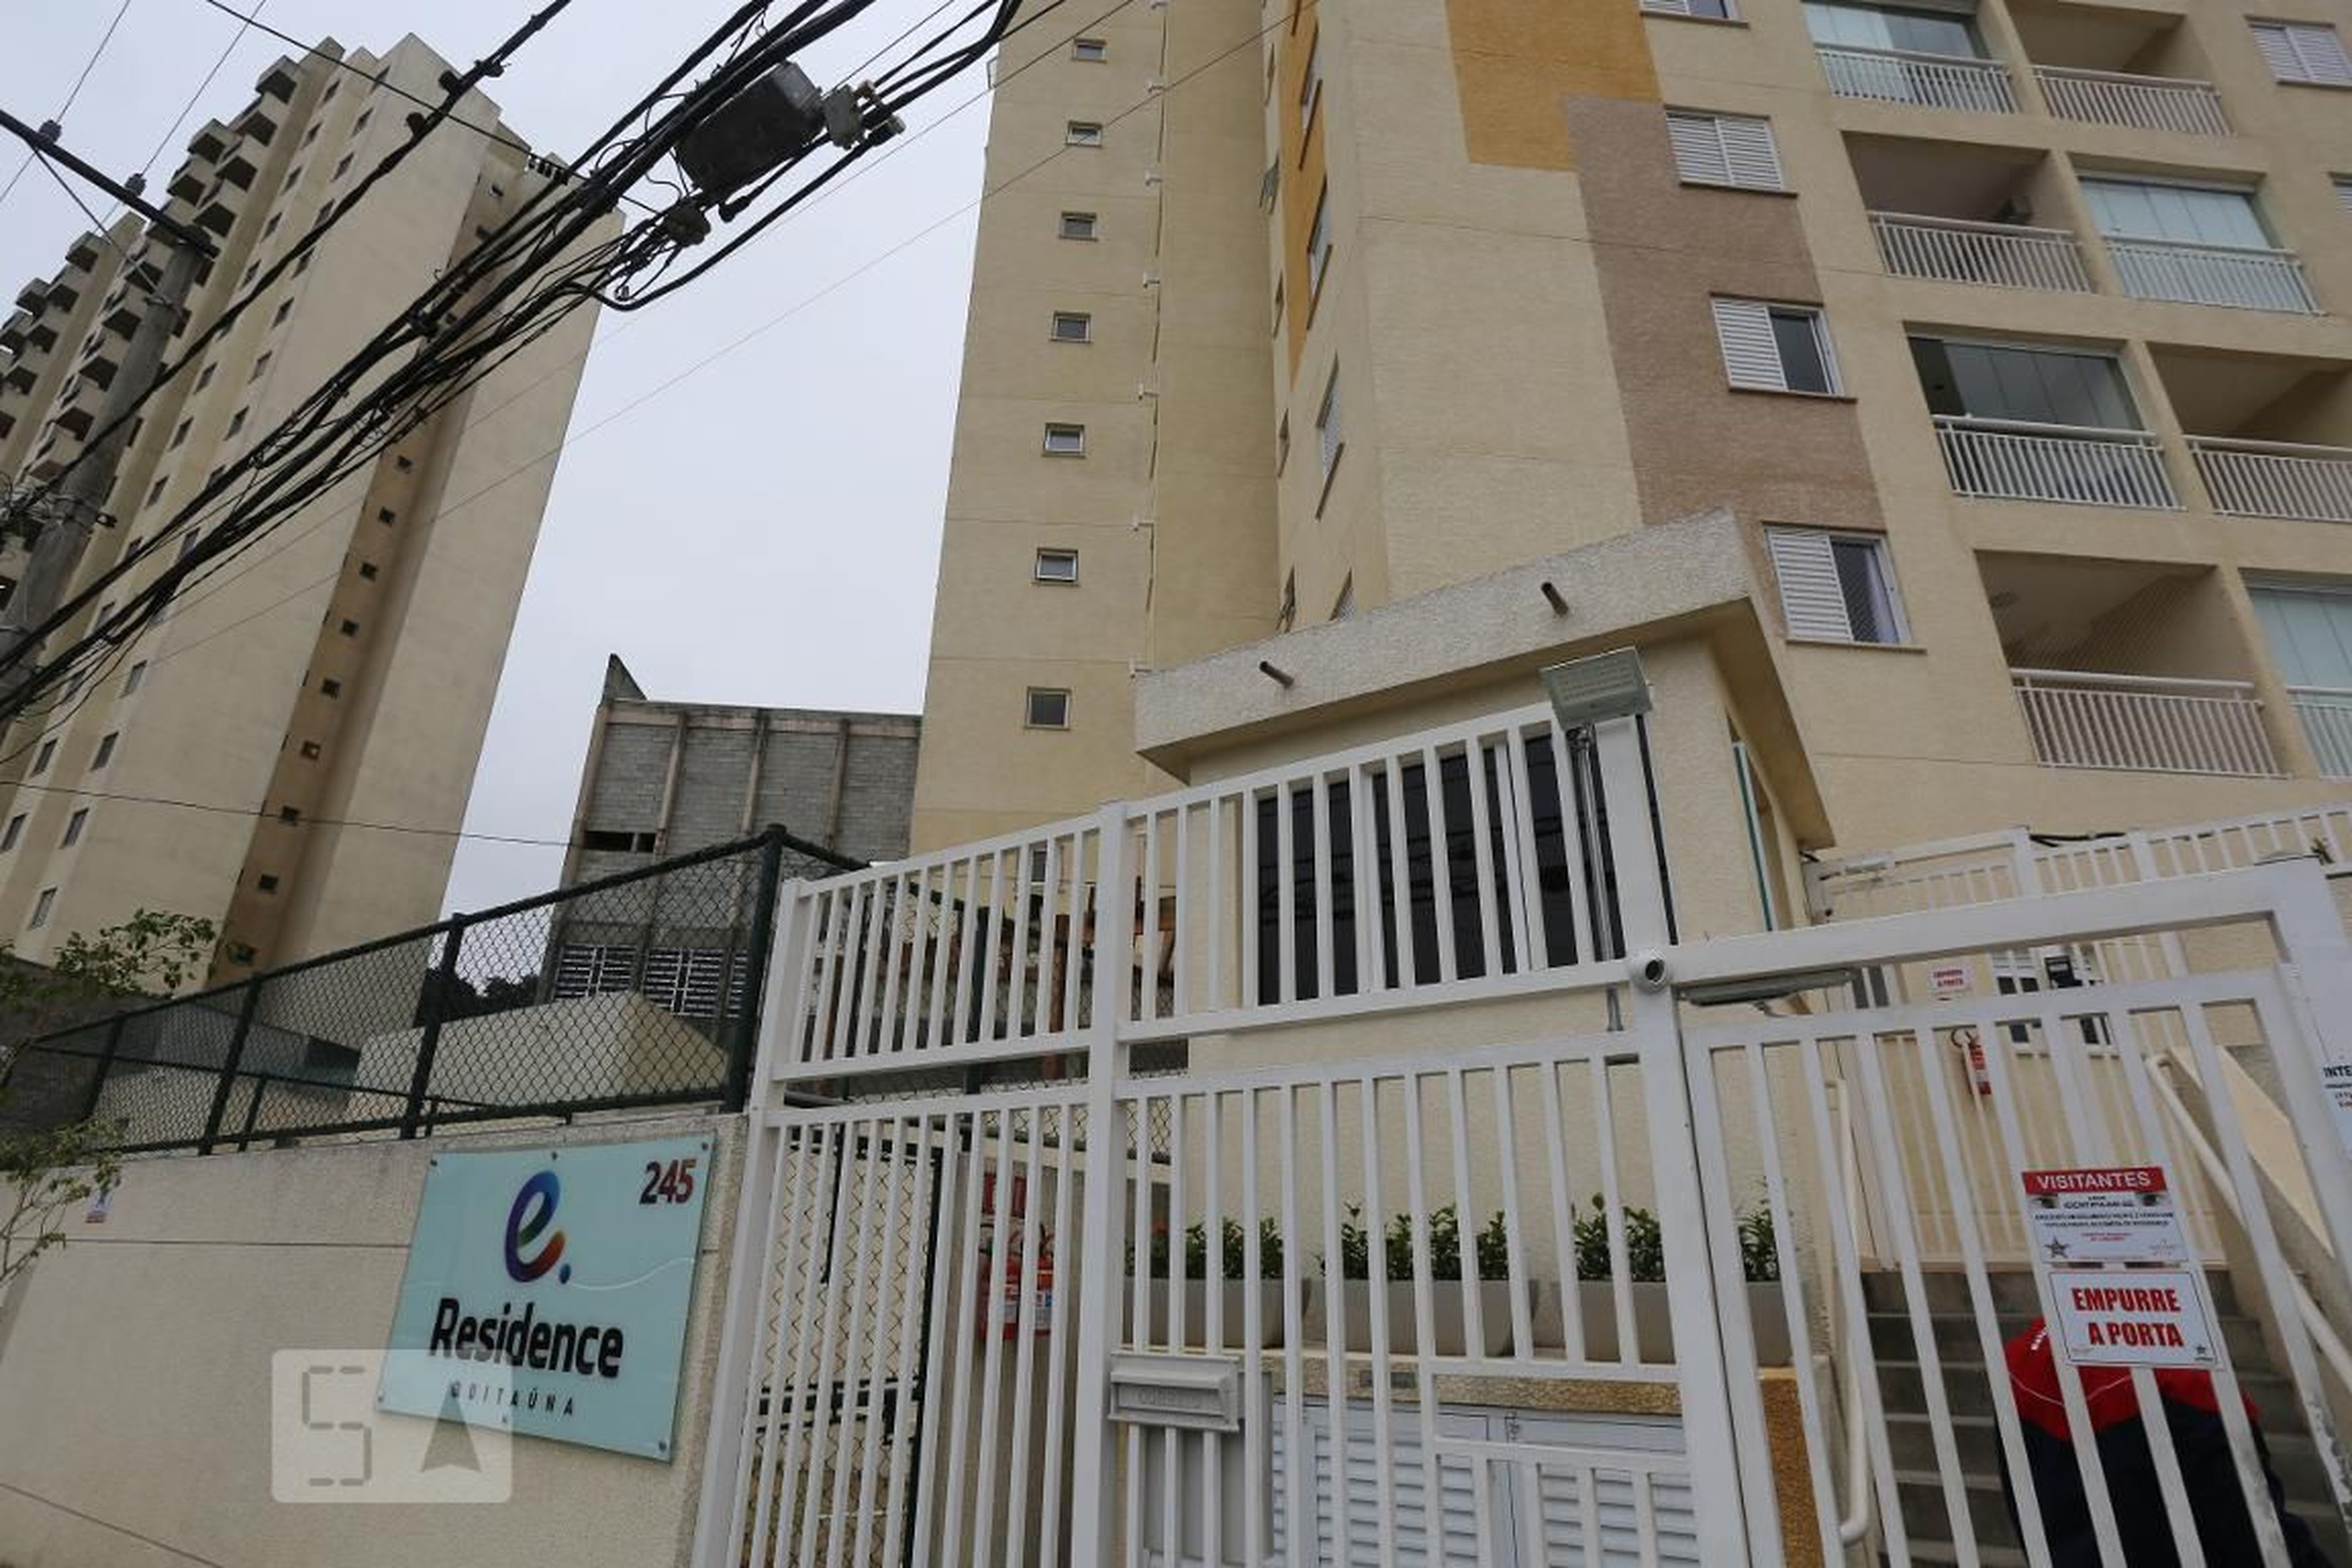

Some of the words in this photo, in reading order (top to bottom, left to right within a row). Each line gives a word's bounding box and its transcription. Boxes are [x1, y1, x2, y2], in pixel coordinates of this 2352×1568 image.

[639, 1159, 697, 1205] 245
[2037, 1171, 2151, 1189] VISITANTES
[2071, 1287, 2180, 1311] EMPURRE
[429, 1298, 623, 1378] Residence
[2088, 1322, 2105, 1346] A
[2107, 1322, 2184, 1346] PORTA
